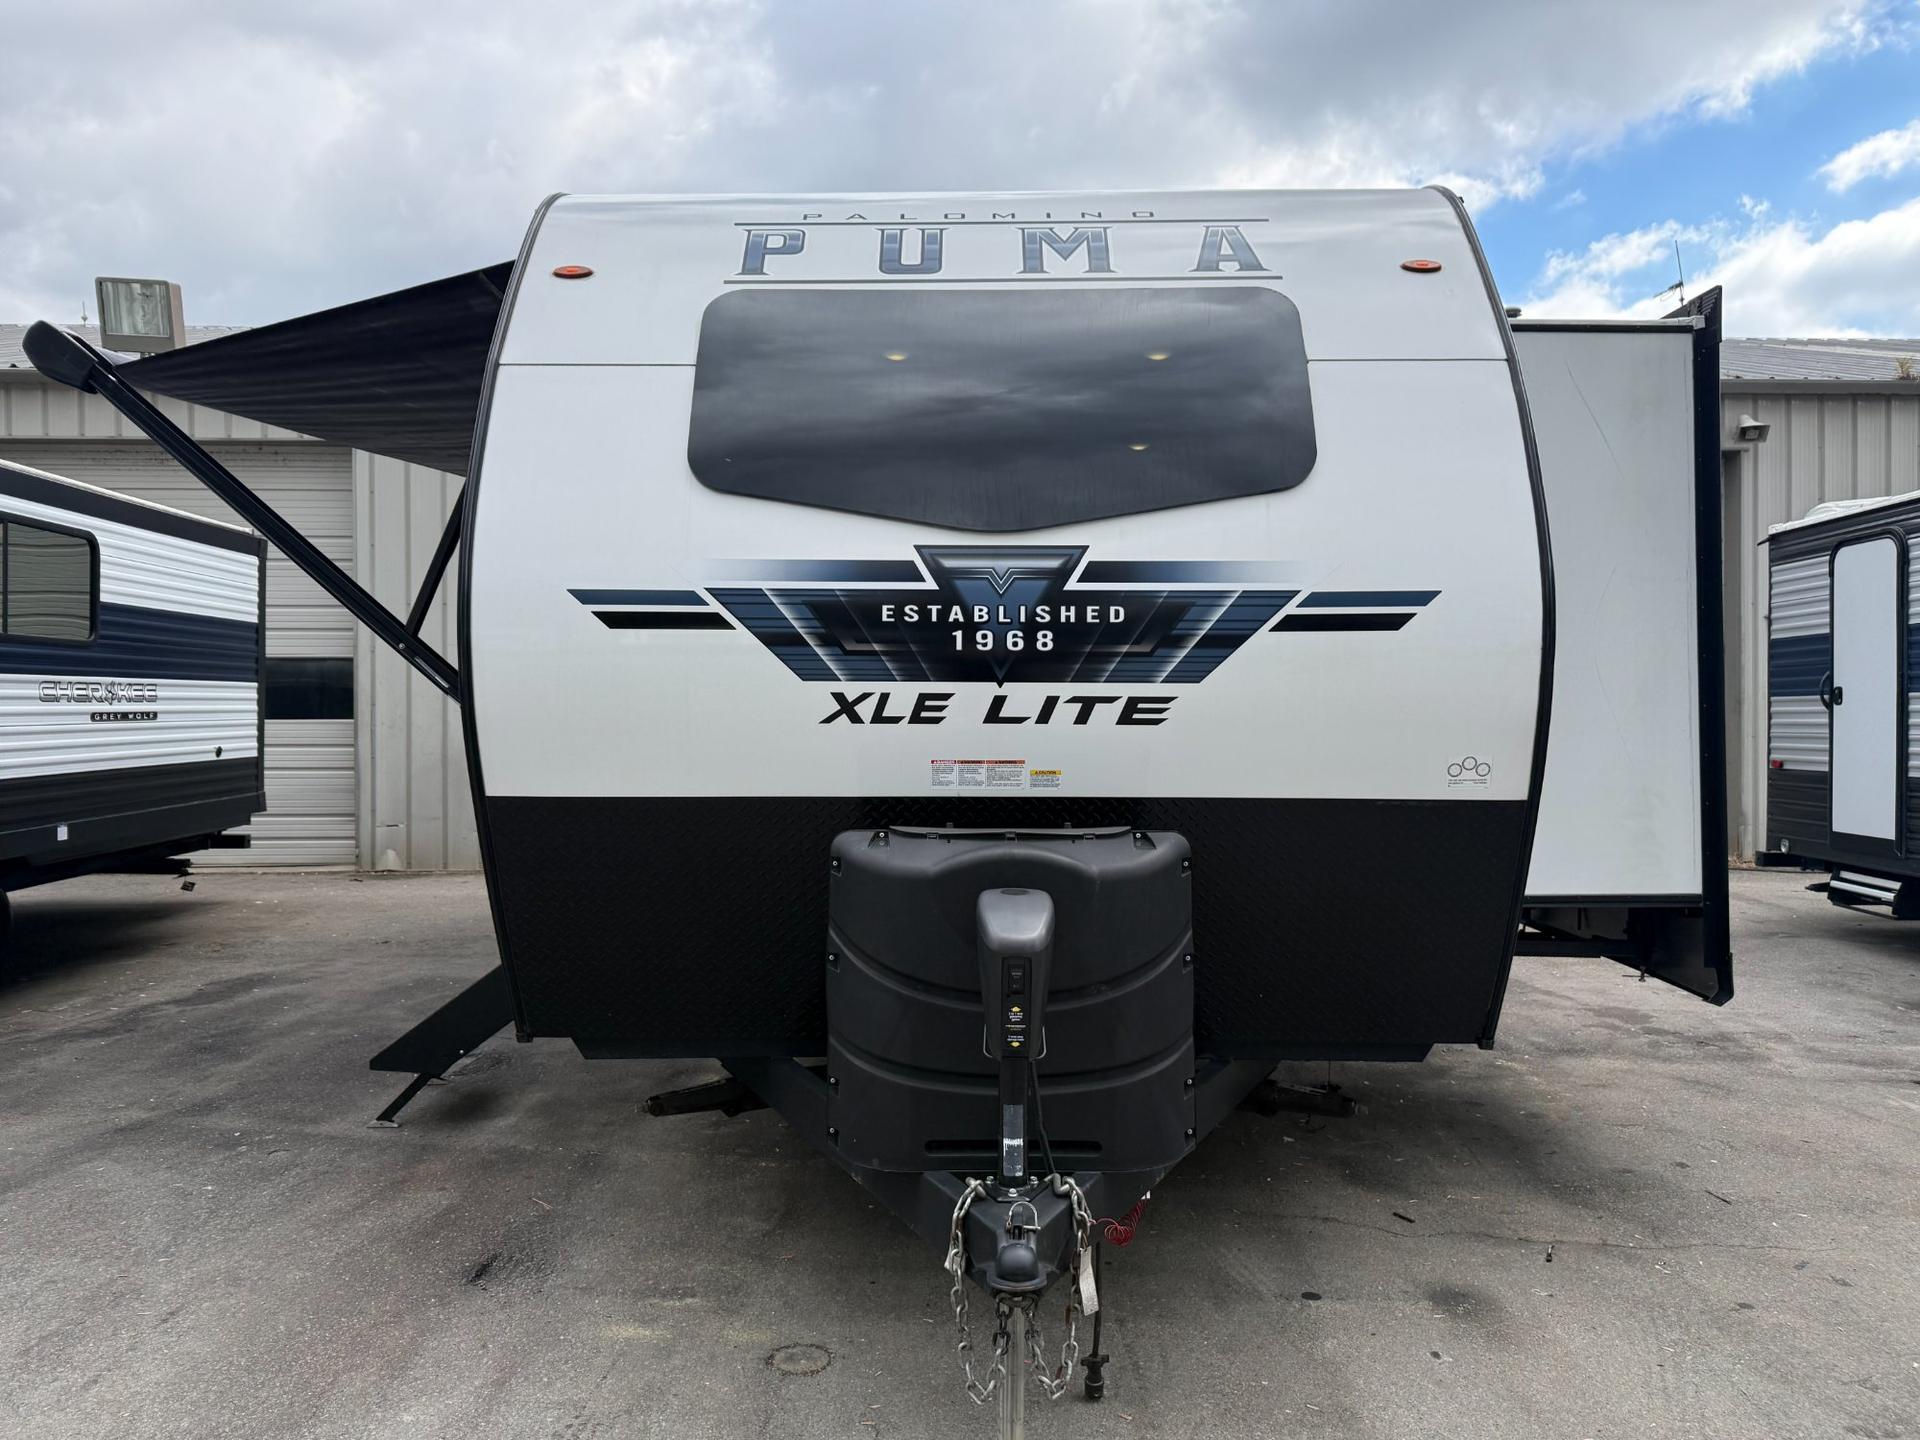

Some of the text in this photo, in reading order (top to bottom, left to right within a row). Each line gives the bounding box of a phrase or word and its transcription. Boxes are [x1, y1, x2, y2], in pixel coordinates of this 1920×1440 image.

[803, 211, 1154, 220] PALOMINO
[734, 225, 1270, 276] PUMA
[881, 604, 1126, 624] ESTABLISHED
[951, 630, 1055, 652] 1968
[39, 681, 158, 705] CHEROKEE
[94, 712, 155, 721] GREY WOLF
[818, 692, 1179, 726] XLE LITE
